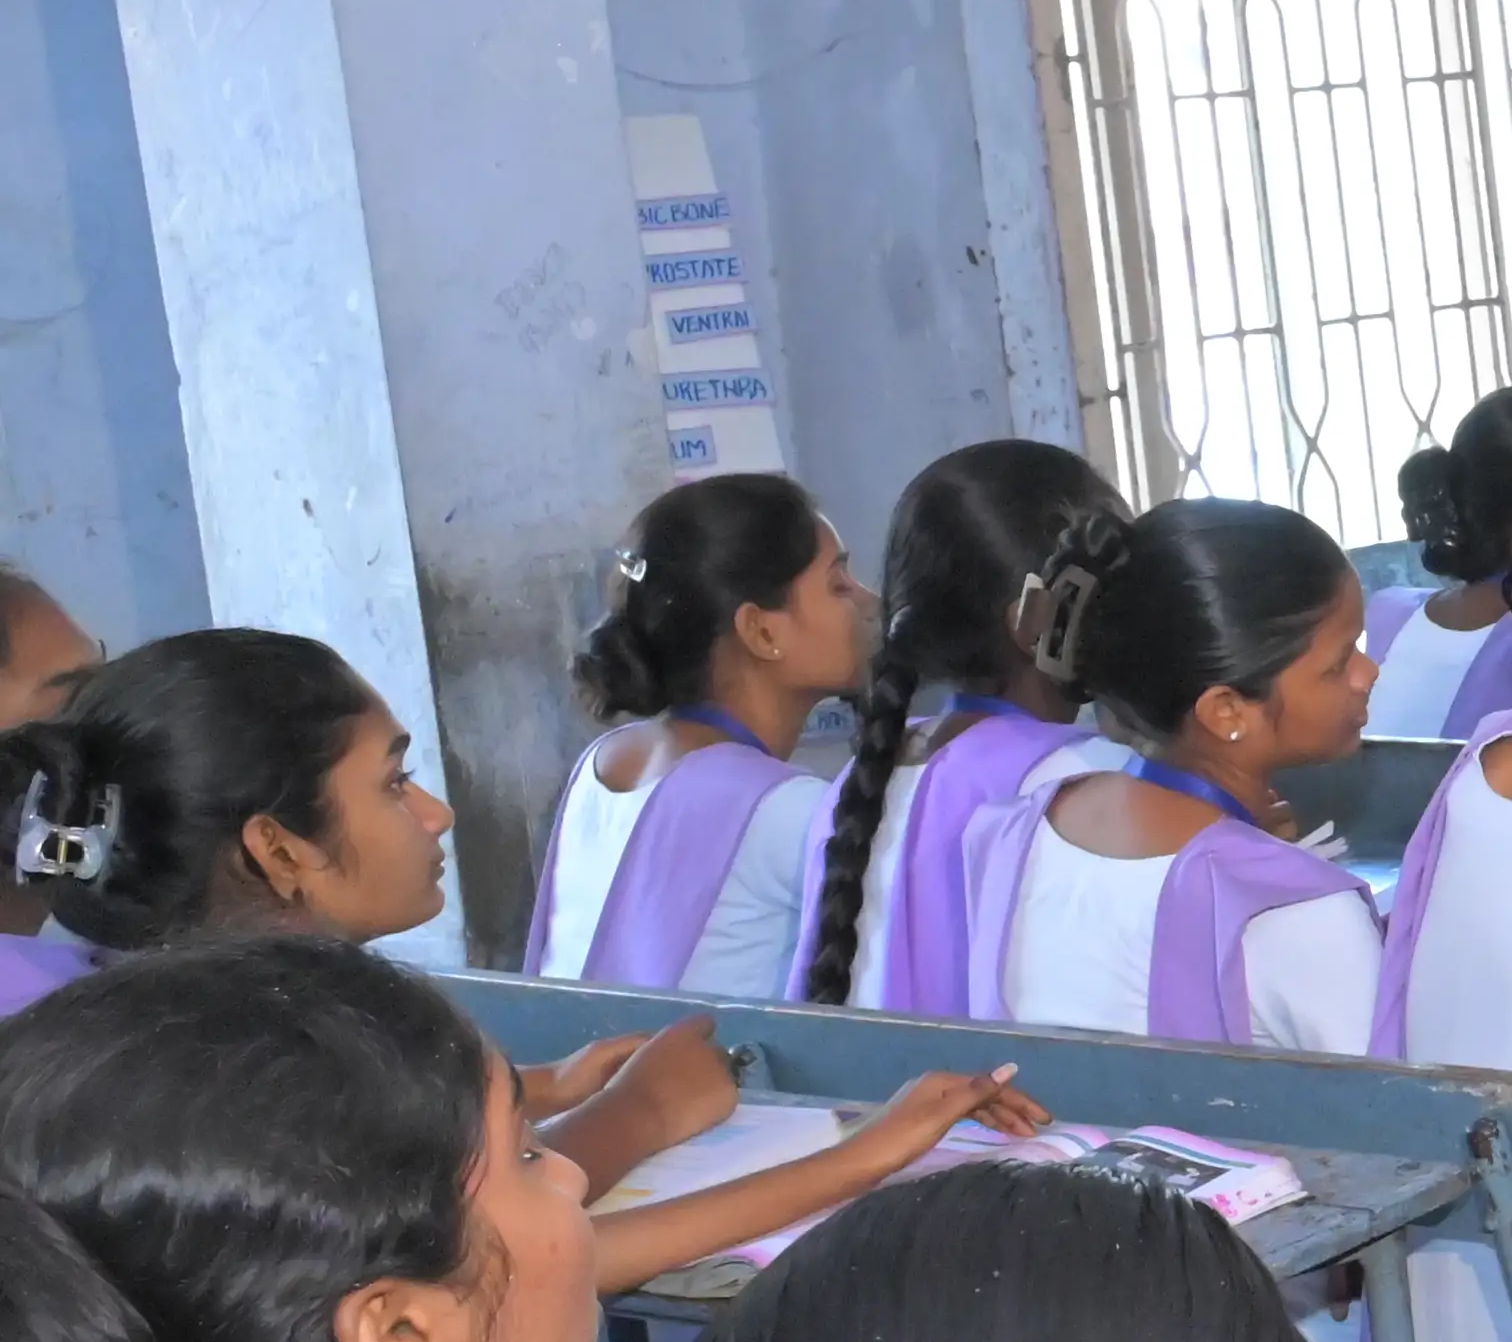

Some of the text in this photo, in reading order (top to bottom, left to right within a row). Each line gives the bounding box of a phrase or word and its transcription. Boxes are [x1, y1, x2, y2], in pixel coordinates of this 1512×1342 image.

[670, 197, 731, 223] BONE
[646, 257, 742, 284] ROSTATE
[662, 376, 768, 402] URETHRA
